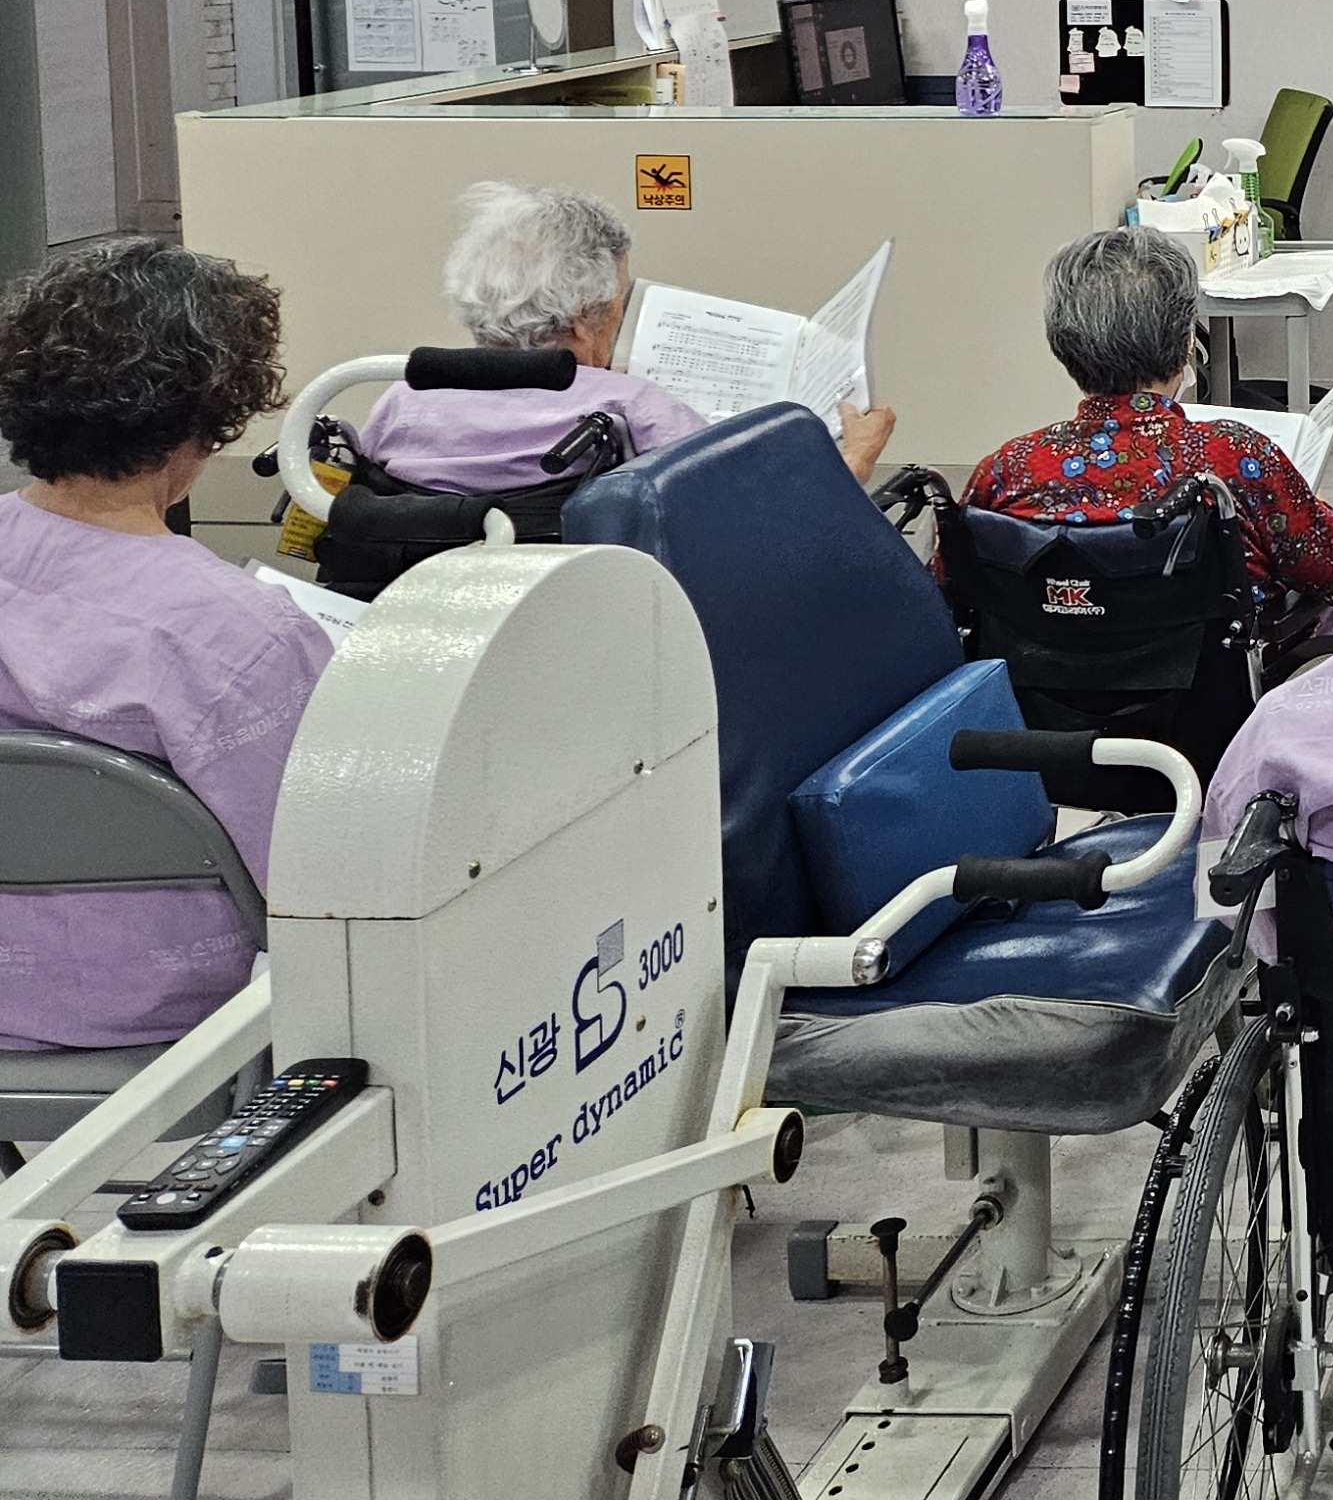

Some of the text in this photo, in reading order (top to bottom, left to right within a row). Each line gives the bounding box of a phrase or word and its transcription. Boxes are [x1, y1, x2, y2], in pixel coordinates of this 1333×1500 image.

[643, 194, 685, 206] 낙상주의
[1046, 586, 1094, 606] MK
[639, 921, 684, 991] 3000
[494, 1011, 561, 1105] 신광
[475, 1027, 685, 1212] Super dynamic
